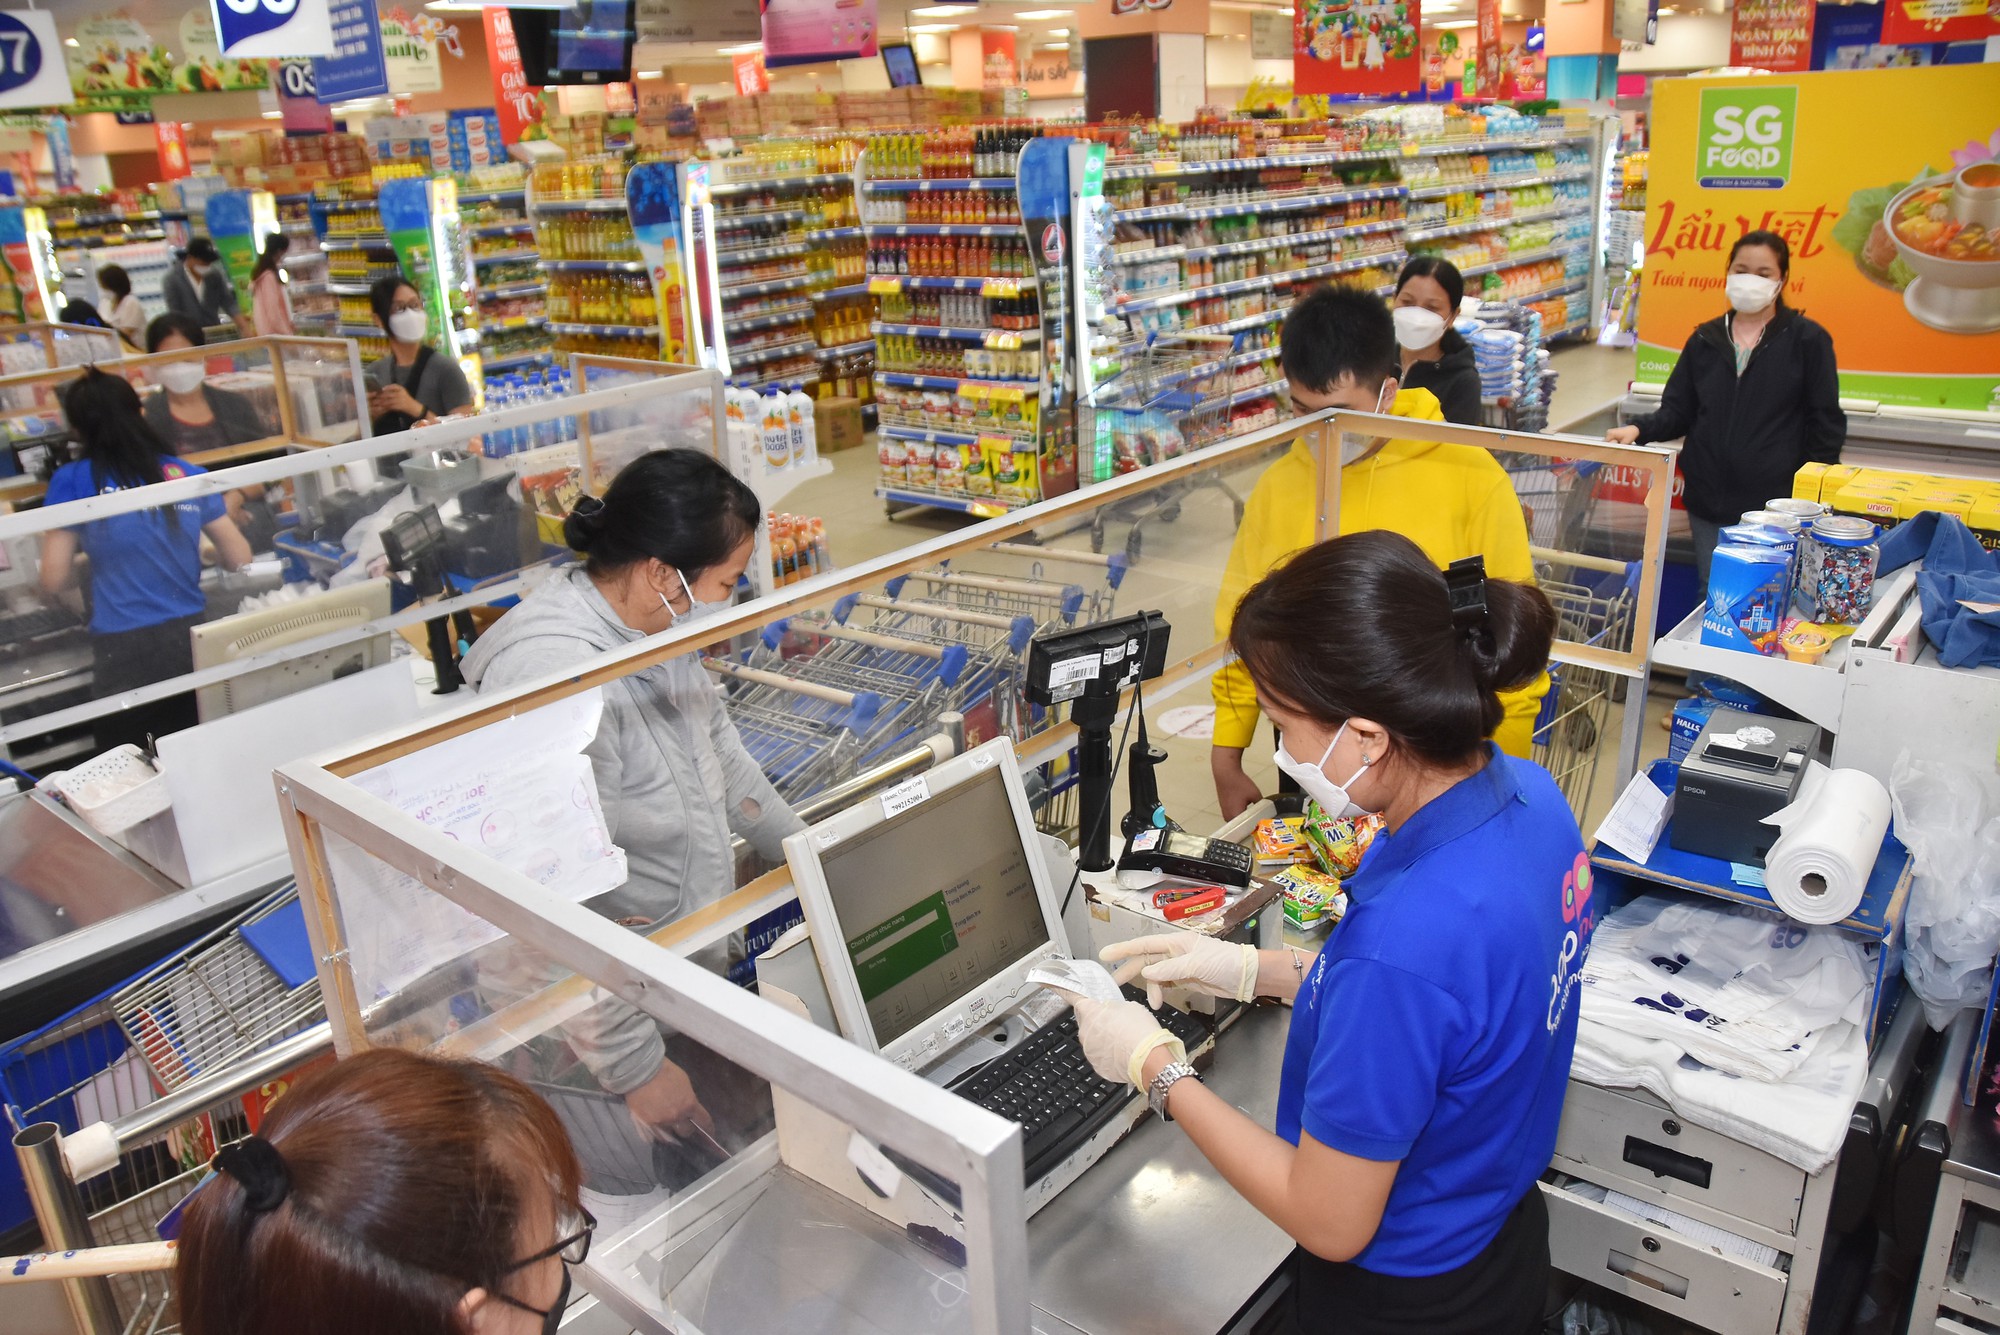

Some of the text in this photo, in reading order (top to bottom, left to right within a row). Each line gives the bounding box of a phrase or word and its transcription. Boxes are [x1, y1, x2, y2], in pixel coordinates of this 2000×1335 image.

[0, 31, 29, 74] 7
[1710, 104, 1783, 146] SG
[1706, 146, 1781, 170] FOOD
[1646, 199, 1726, 260] Lẩu
[1653, 269, 1684, 287] Tươi
[1867, 502, 1893, 513] union
[1683, 784, 1706, 796] EPSON
[850, 915, 906, 949] Chon phim chuc nang
